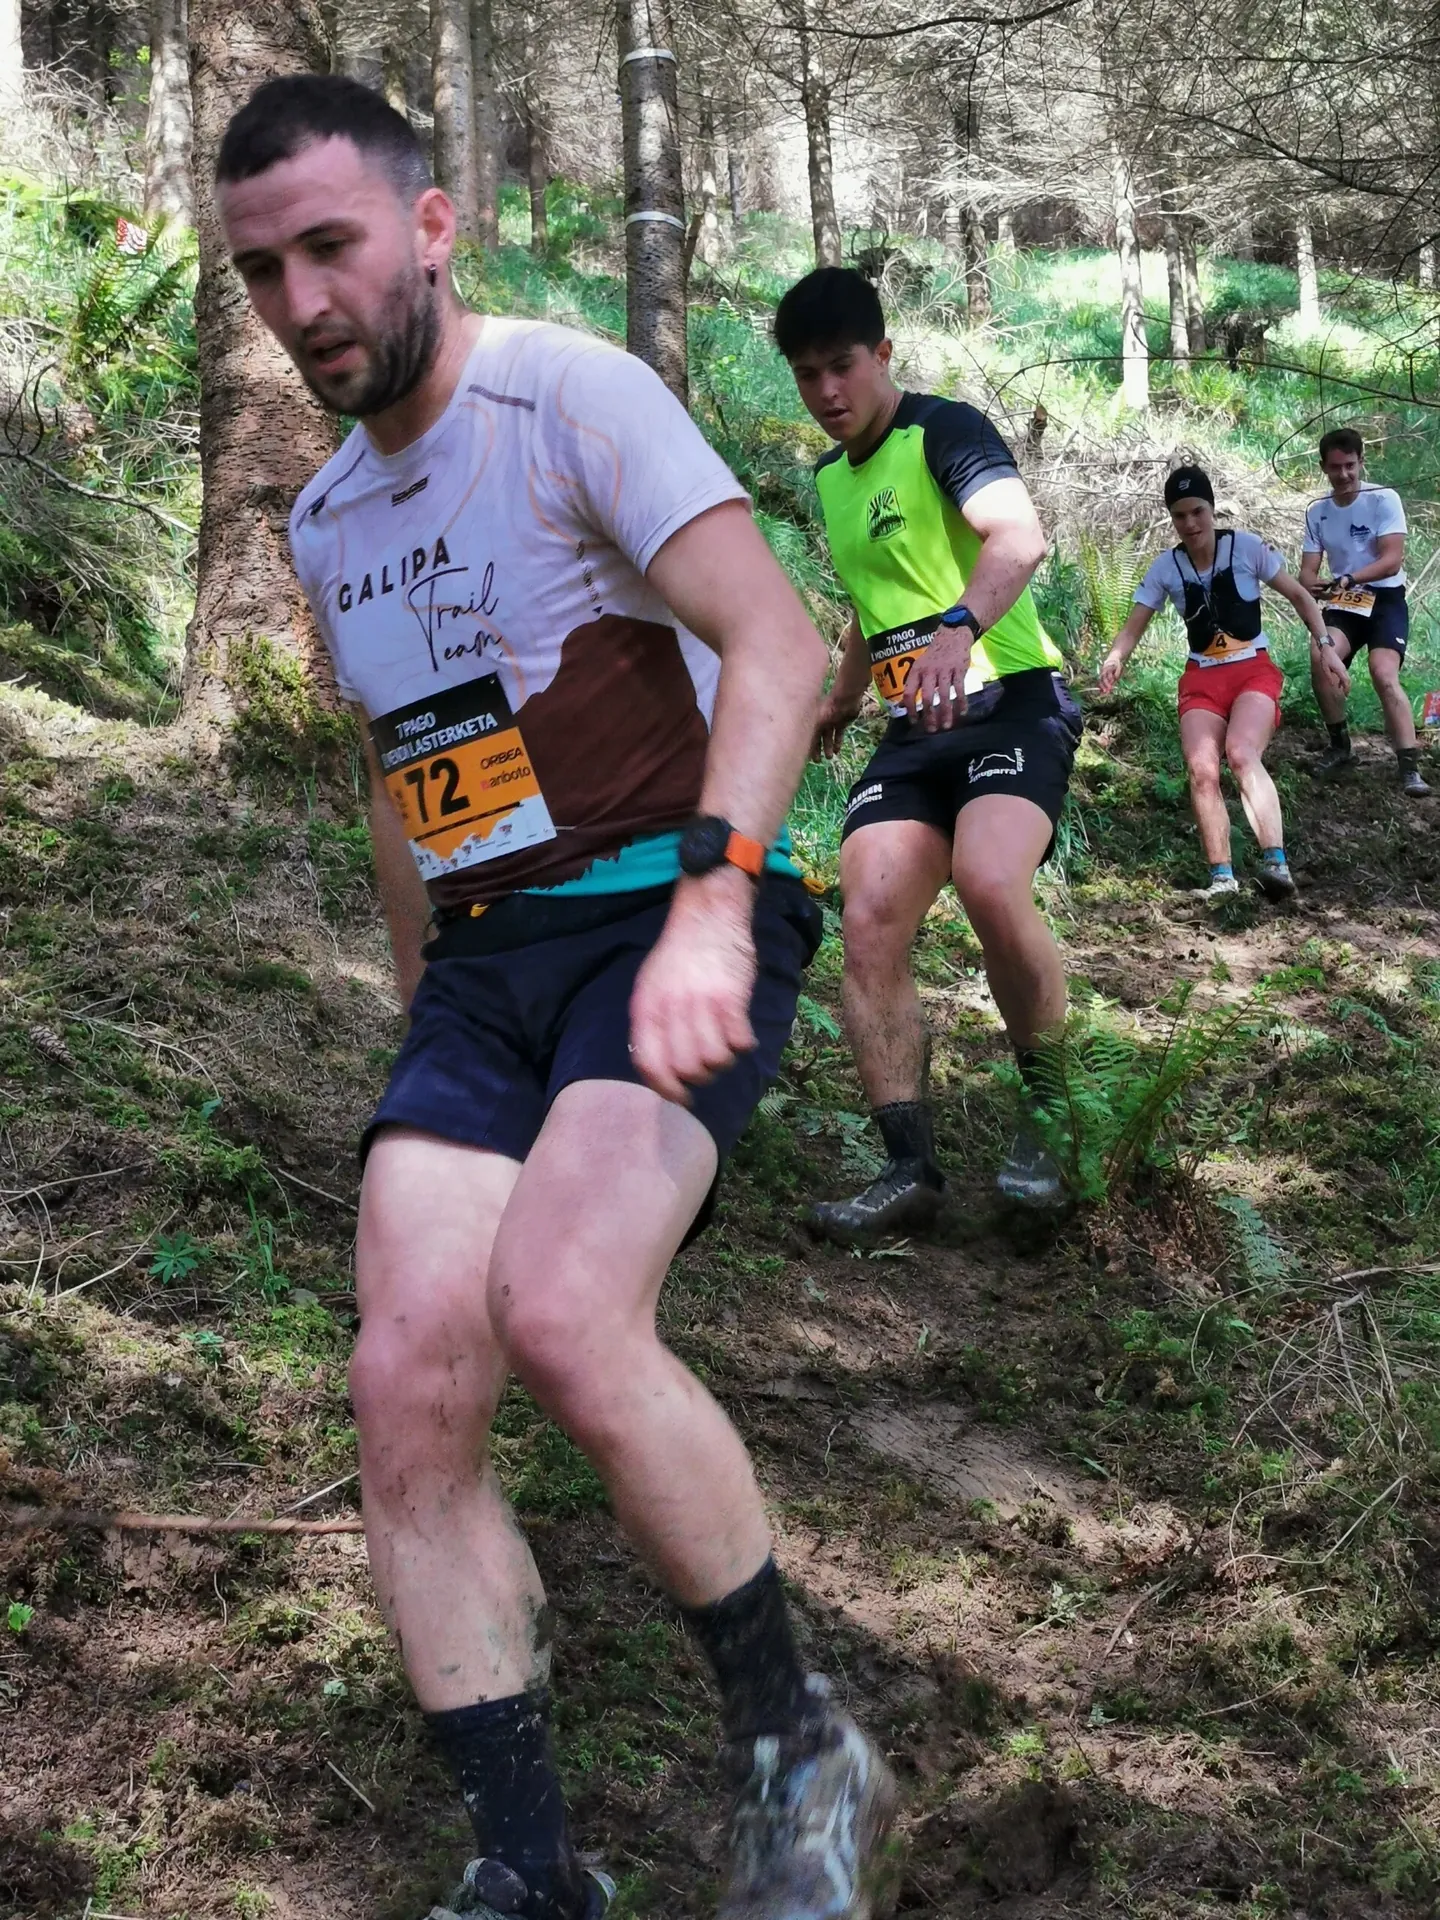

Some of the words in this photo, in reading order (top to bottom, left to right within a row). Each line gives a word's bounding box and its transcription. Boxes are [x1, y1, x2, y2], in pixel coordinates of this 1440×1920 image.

[339, 537, 450, 613] GALIPA
[408, 561, 499, 672] Trail
[892, 628, 916, 644] PAGO
[895, 632, 937, 654] LASTERK
[1216, 635, 1228, 648] 4
[480, 747, 523, 770] ORBEA
[404, 758, 470, 824] 72
